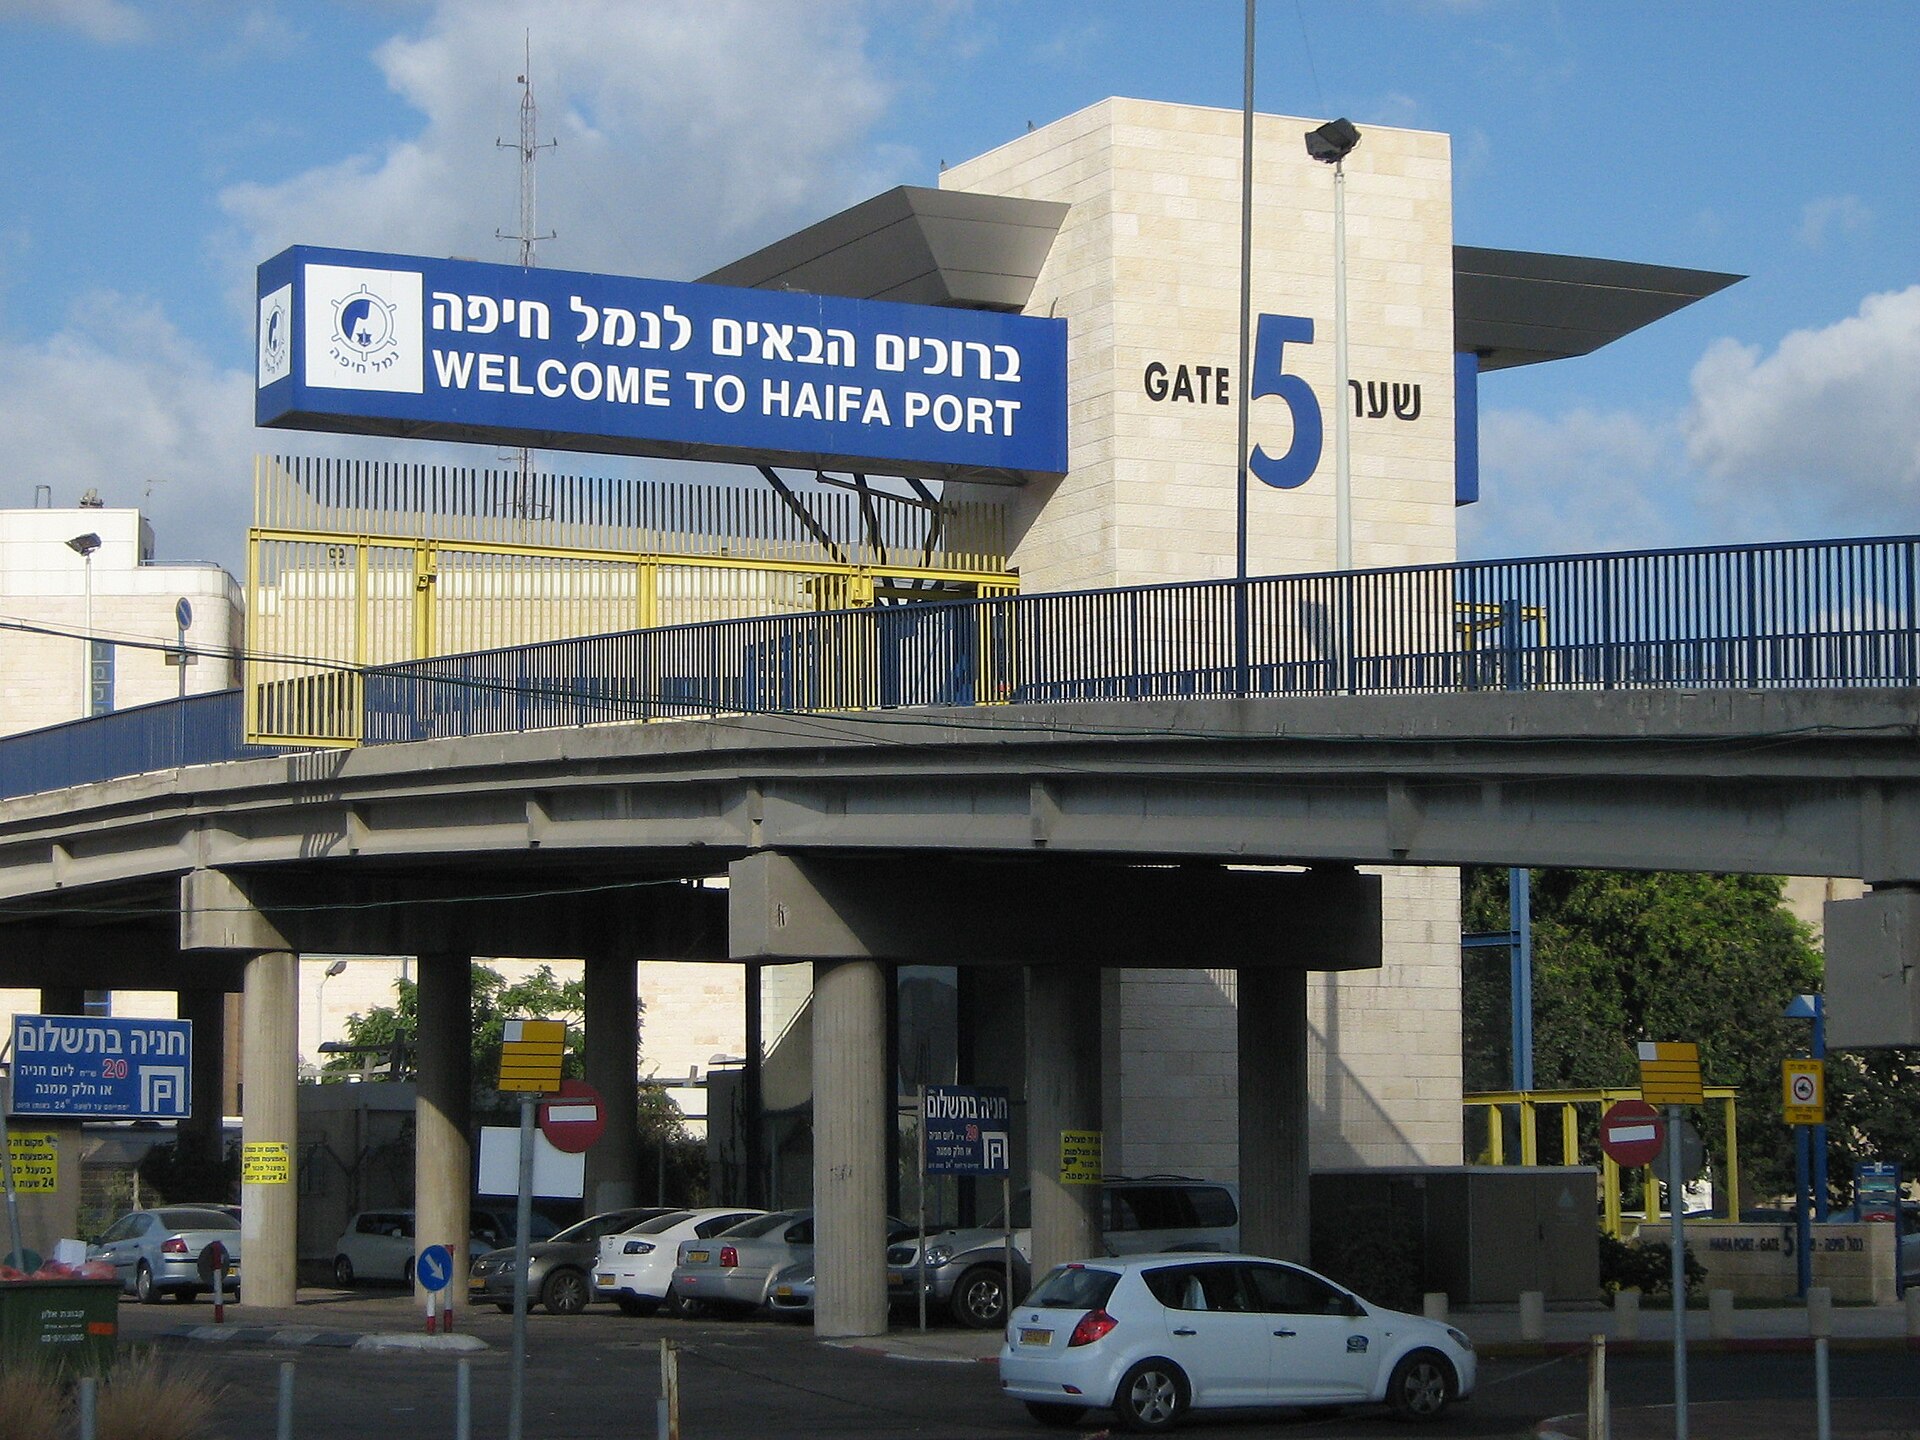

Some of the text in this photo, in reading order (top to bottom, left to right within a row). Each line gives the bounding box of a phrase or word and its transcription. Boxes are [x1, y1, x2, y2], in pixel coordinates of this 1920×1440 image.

[432, 291, 1021, 383] ברוכים הבאים לנמל חיפה
[330, 347, 399, 373] נמל חיפה
[432, 349, 1021, 437] WELCOME TO HAIFA PORT
[1144, 361, 1229, 405] GATE
[1249, 313, 1323, 489] 5
[1348, 379, 1421, 421] שער
[18, 1020, 185, 1055] חניה בתשלום
[21, 1065, 46, 1076] חניה
[51, 1063, 74, 1077] ליום
[102, 1059, 128, 1079] 20
[36, 1082, 112, 1097] או חלק ממנה
[927, 1089, 1007, 1119] חניה בתשלום
[42, 1177, 54, 1188] 24
